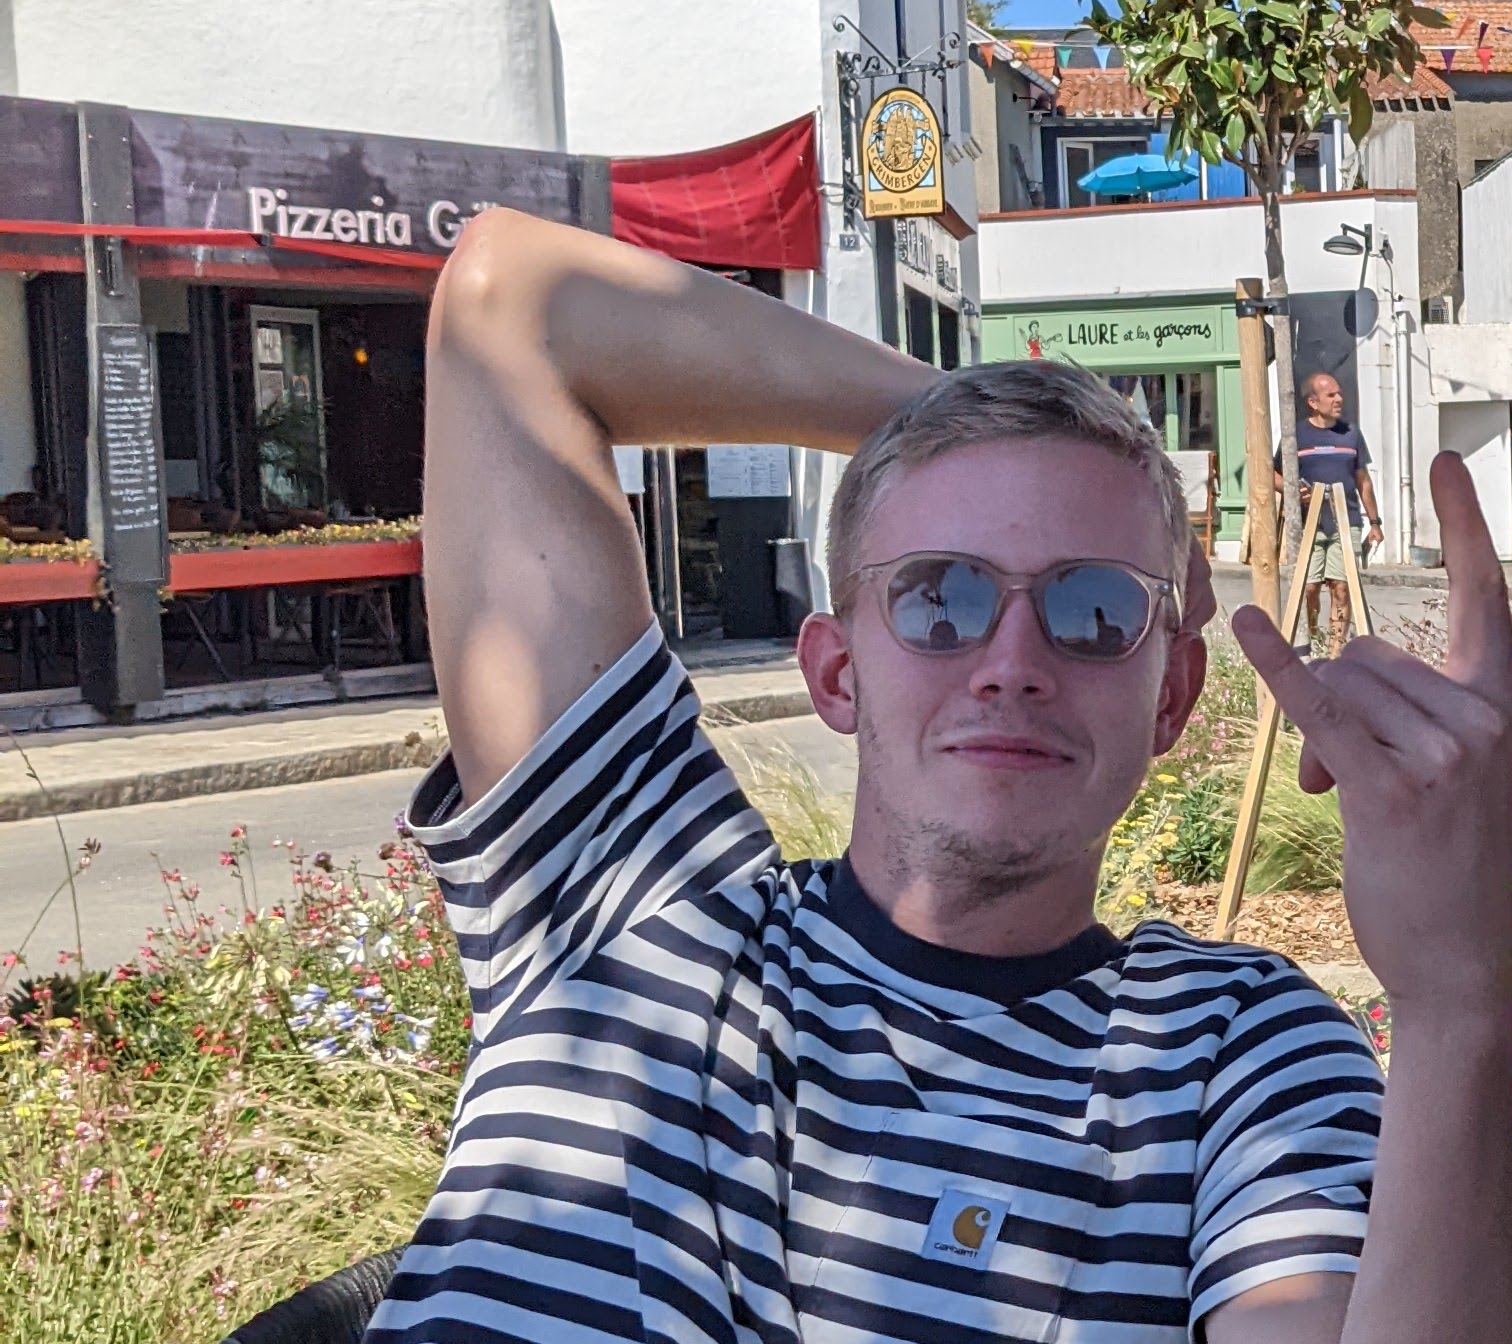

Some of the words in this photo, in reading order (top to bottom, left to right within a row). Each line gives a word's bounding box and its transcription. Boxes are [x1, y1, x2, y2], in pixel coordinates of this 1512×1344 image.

[871, 156, 932, 189] GRIMBERGEN
[249, 186, 412, 246] Pizzeria
[844, 236, 856, 248] 12
[1068, 323, 1119, 346] LAURE
[1123, 330, 1133, 343] et
[1136, 325, 1150, 341] les
[1153, 322, 1212, 348] garçons
